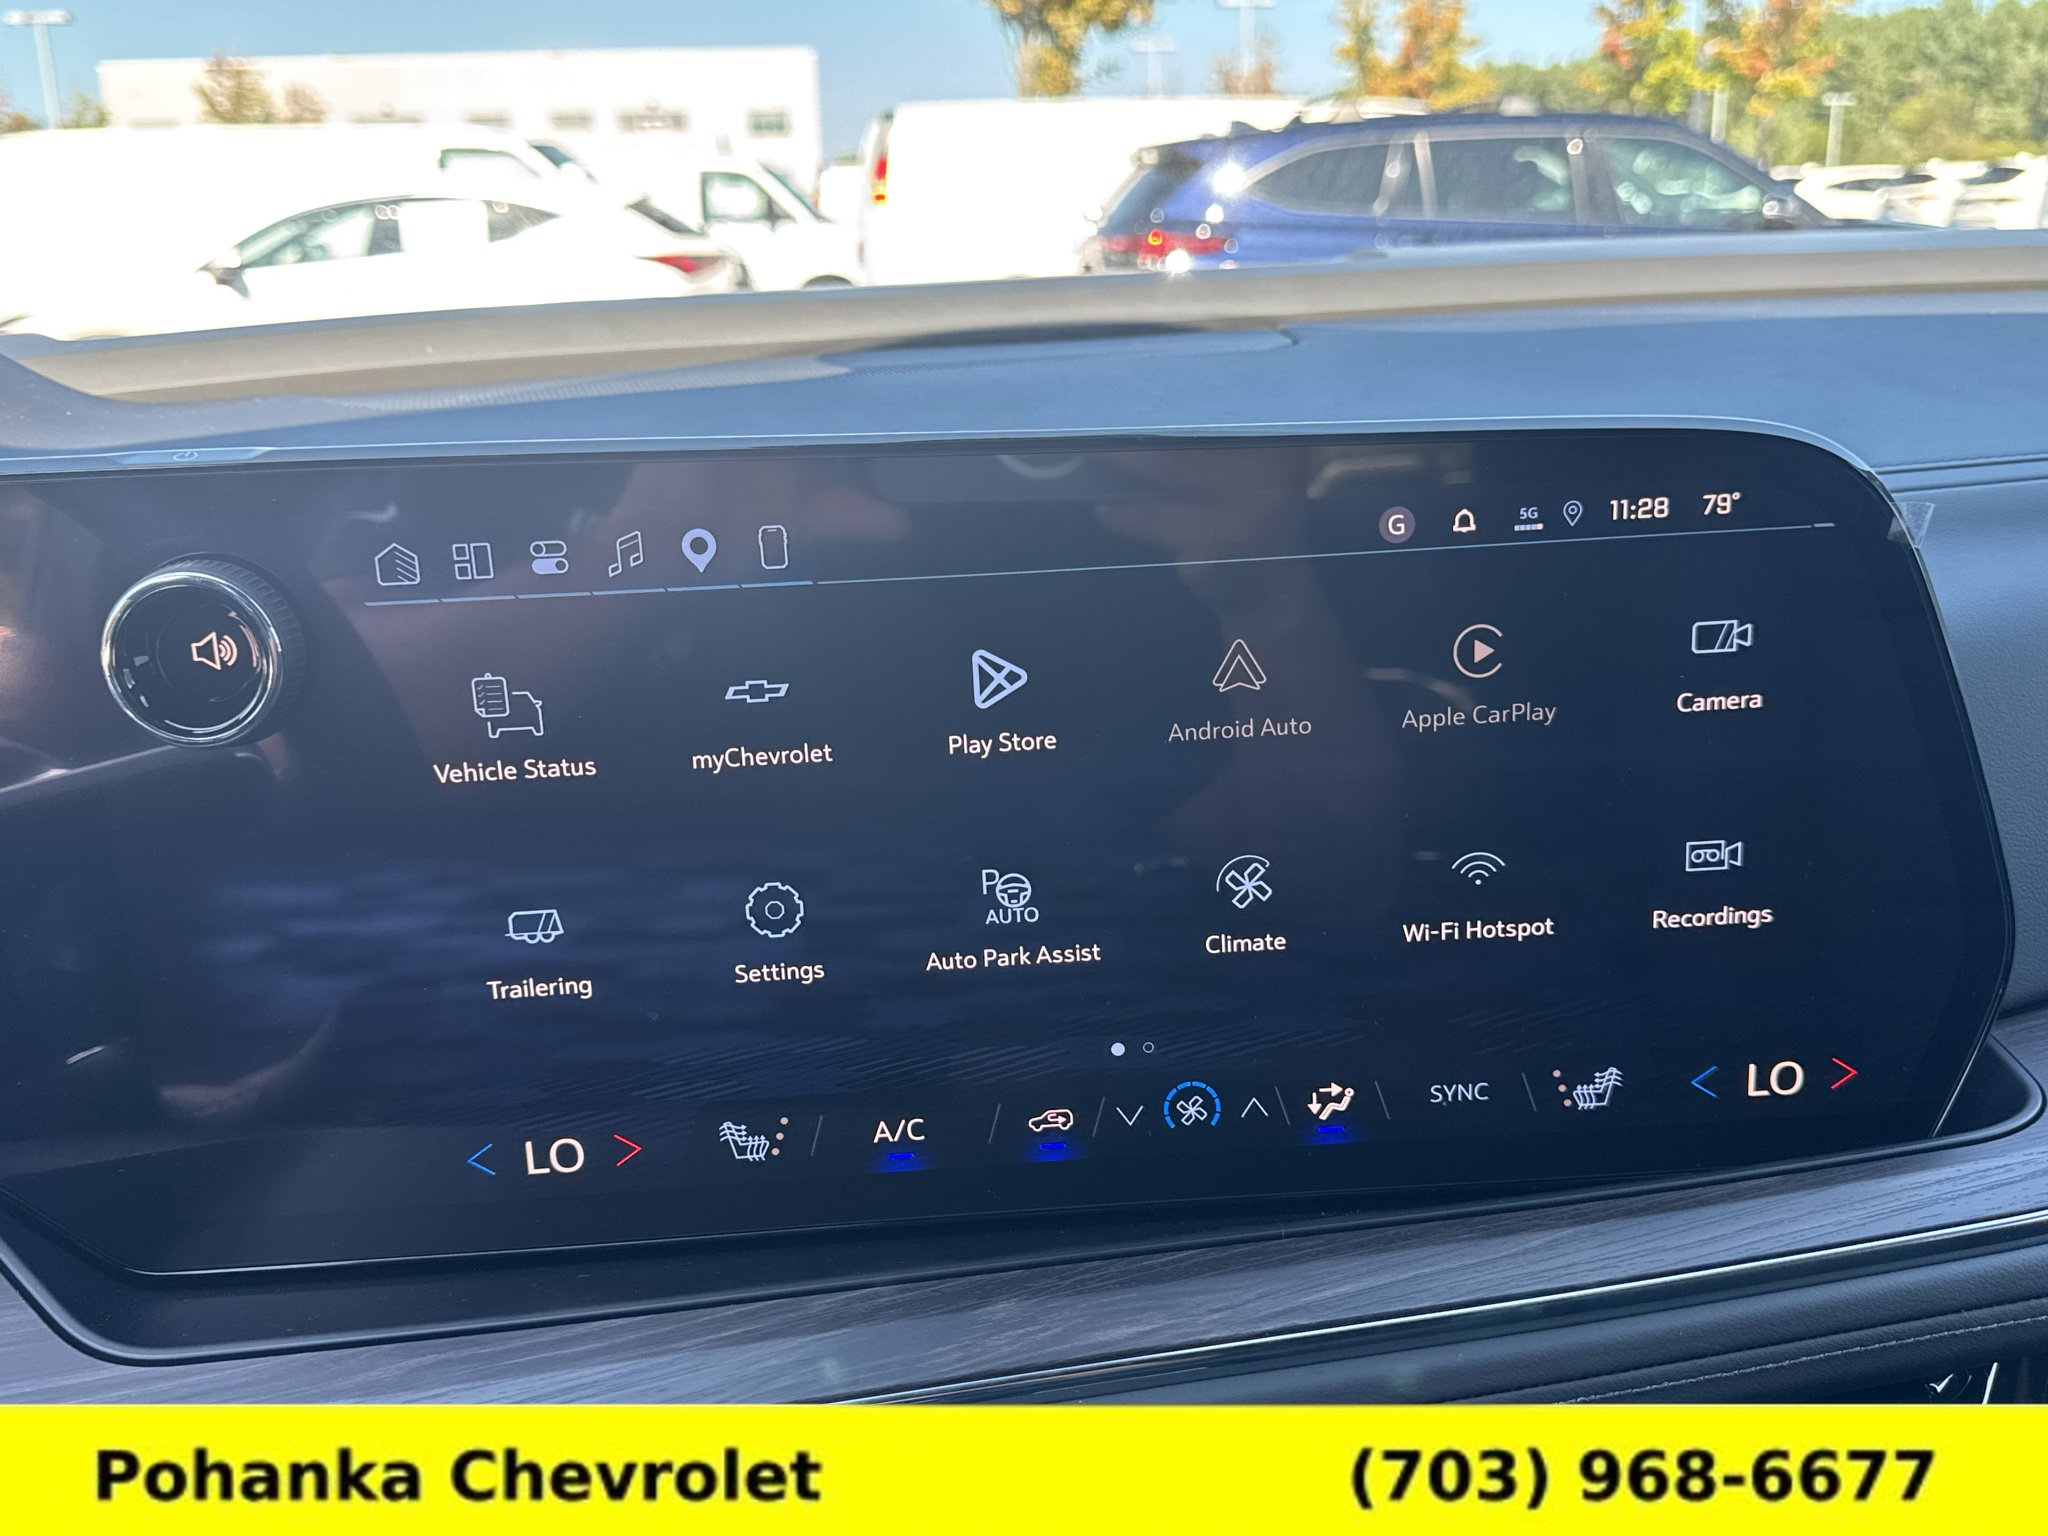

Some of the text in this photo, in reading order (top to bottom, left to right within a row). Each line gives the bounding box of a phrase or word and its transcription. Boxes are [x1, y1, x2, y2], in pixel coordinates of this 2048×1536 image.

[1519, 506, 1539, 520] 5G
[1610, 496, 1669, 521] 11:28
[1388, 514, 1405, 535] G
[1676, 692, 1763, 713] Camera
[1168, 717, 1312, 742] Android Auto
[1401, 701, 1557, 733] Apple CarPlay
[692, 742, 834, 771] myChevrolet
[948, 732, 1057, 759] Play Store
[432, 758, 597, 784] Vehicle Status
[985, 907, 1040, 925] AUTO
[1652, 905, 1774, 929] Recordings
[1402, 917, 1555, 943] Wi-Fi Hotspot
[1205, 933, 1287, 954] Climate
[925, 943, 1102, 971] Auto Park Assist
[734, 962, 825, 985] Settings
[485, 977, 593, 1000] Trailering
[1747, 1060, 1804, 1097] LO
[1430, 1082, 1489, 1103] SYNC
[873, 1118, 926, 1144] A/C
[524, 1138, 585, 1175] LO
